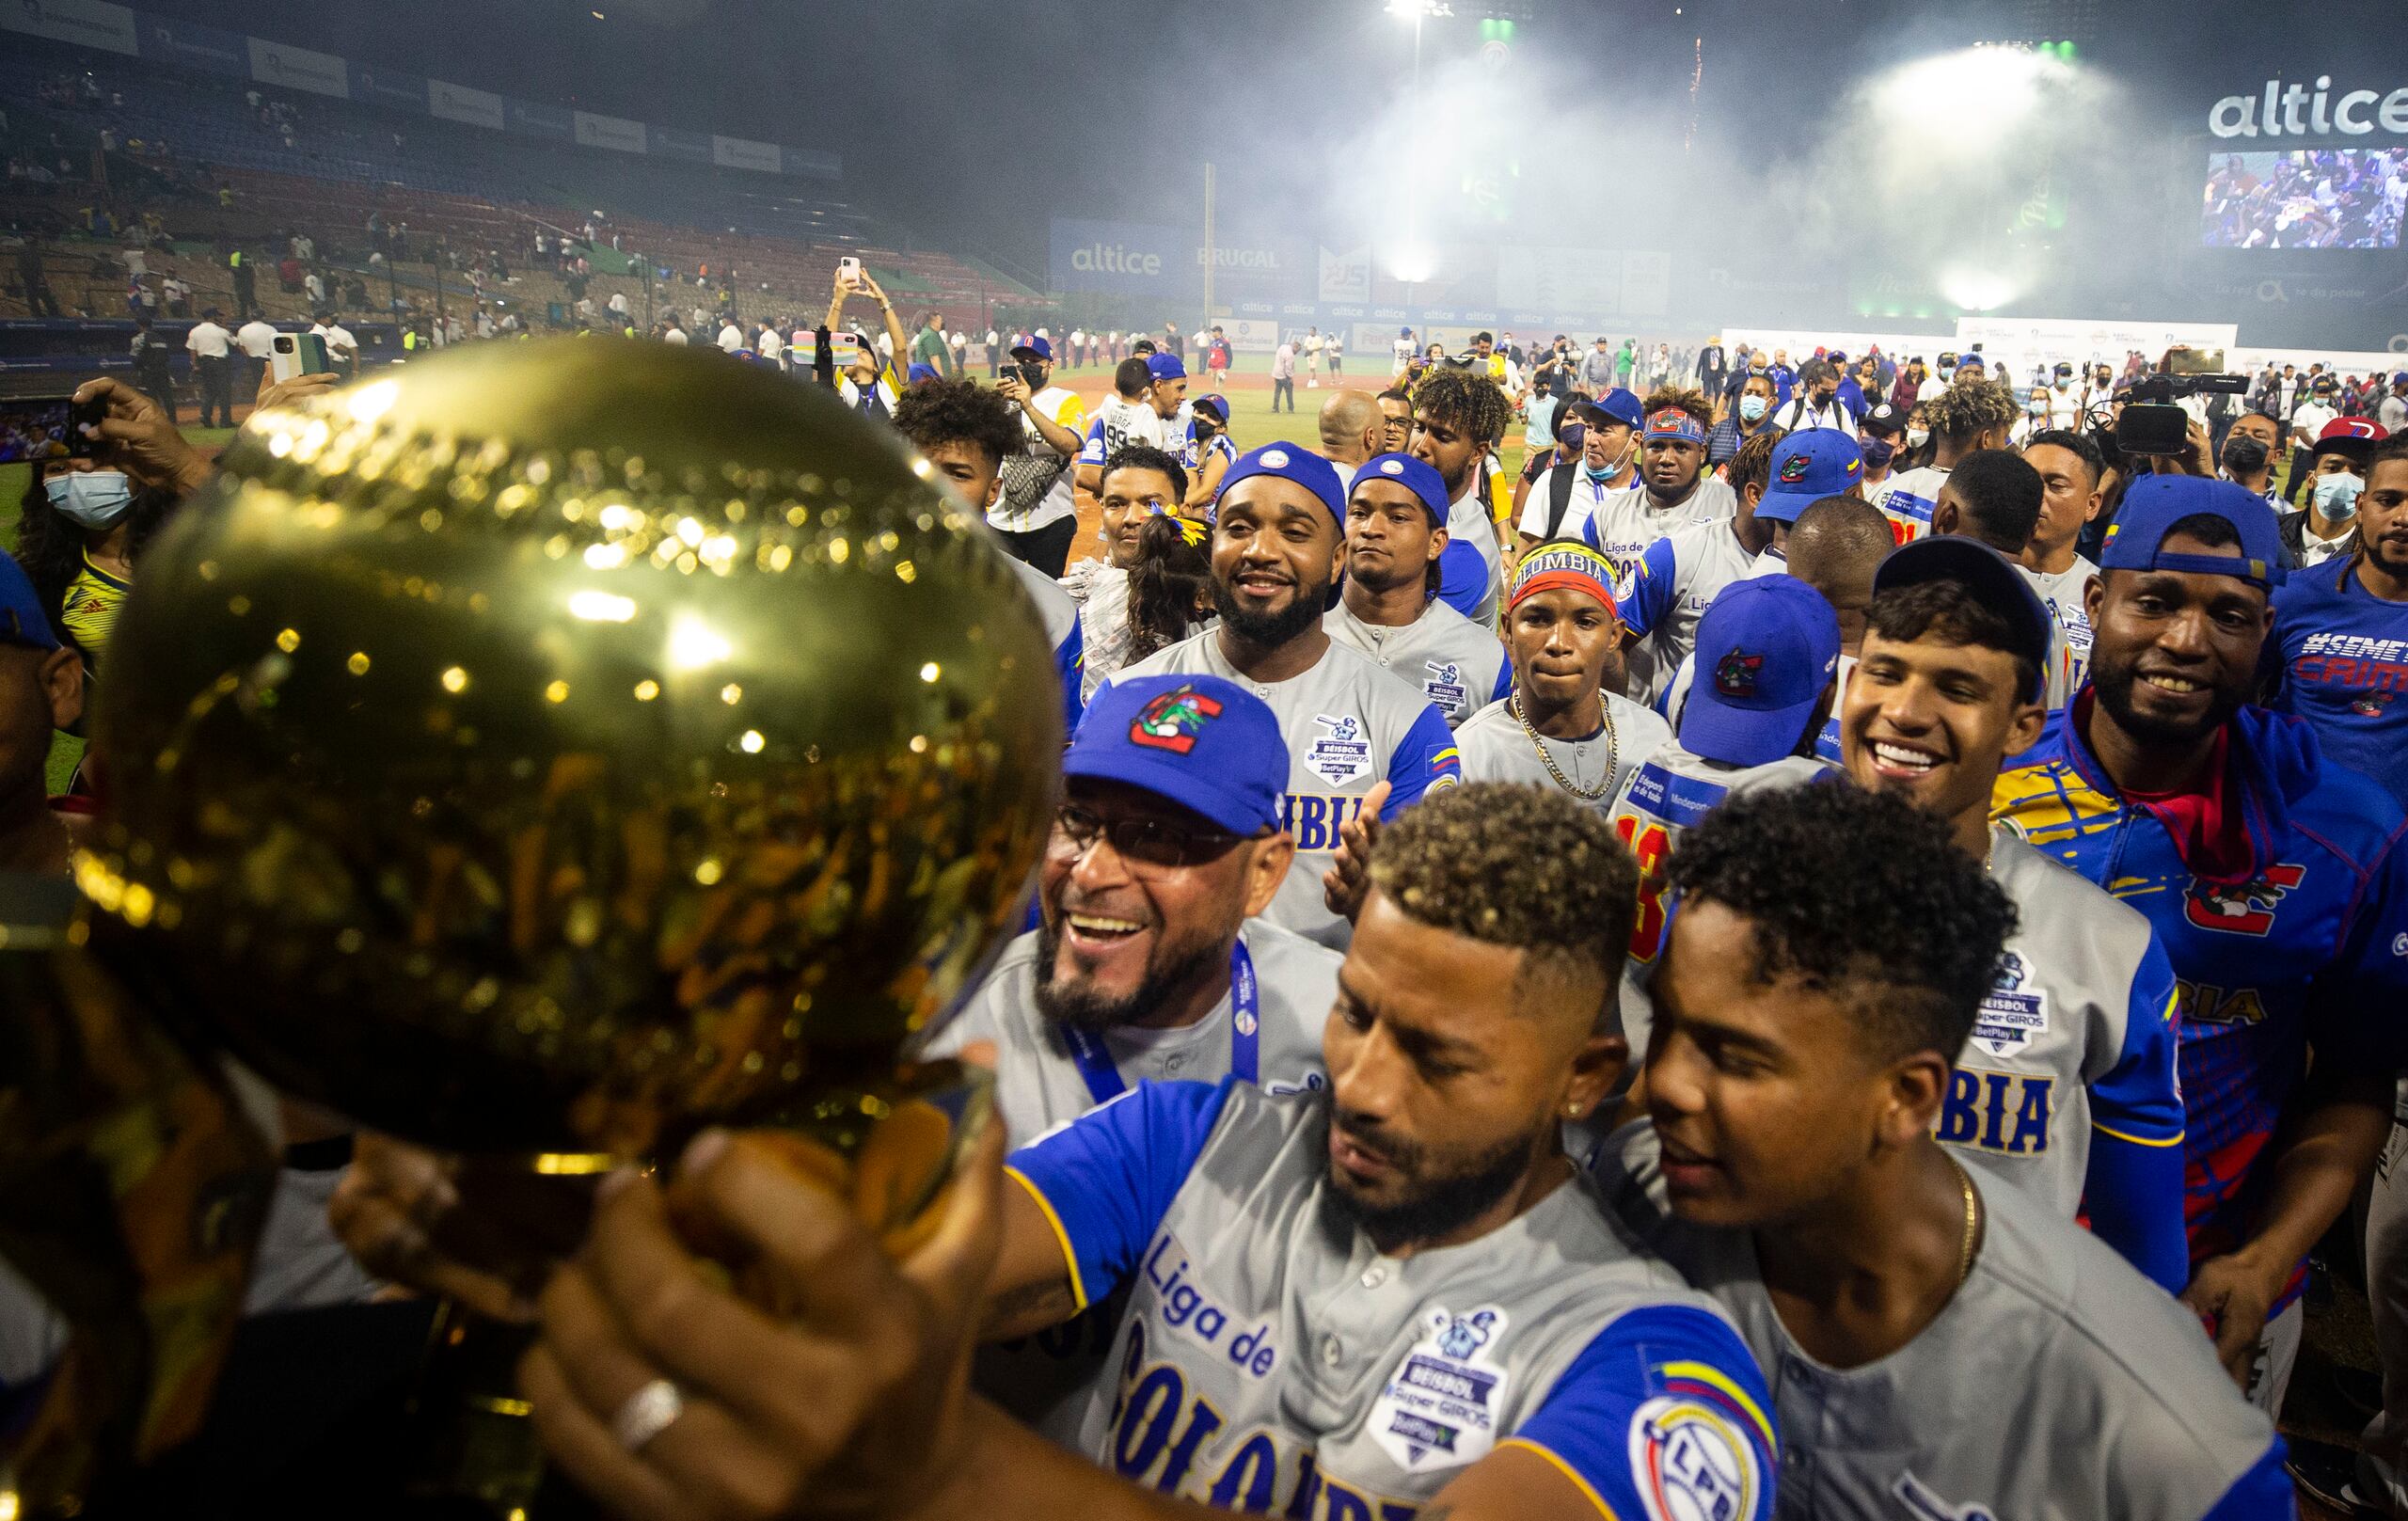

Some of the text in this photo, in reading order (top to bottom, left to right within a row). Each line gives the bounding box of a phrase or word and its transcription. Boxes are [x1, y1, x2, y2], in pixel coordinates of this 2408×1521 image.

[2208, 74, 2408, 138] altice
[1070, 242, 1163, 277] altice
[1197, 247, 1280, 269] BRUGAL
[1242, 303, 1274, 313] altice
[1283, 304, 1315, 315] altice
[1332, 306, 1364, 317] altice
[1374, 308, 1406, 319] altice
[1423, 309, 1455, 321] altice
[1465, 311, 1497, 322] altice
[1513, 313, 1545, 325] altice
[1554, 315, 1585, 325] altice
[1106, 424, 1129, 452] 99
[1605, 541, 1643, 553] Liga de
[1323, 743, 1359, 754] BÉISBOL
[1316, 753, 1370, 764] Super GIROS
[1322, 764, 1345, 774] BetPlay
[2005, 1014, 2044, 1028] GIROS
[1976, 1026, 2011, 1041] BetPlay
[1147, 1234, 1275, 1378] Liga de
[1393, 1386, 1492, 1433] Super GIROS
